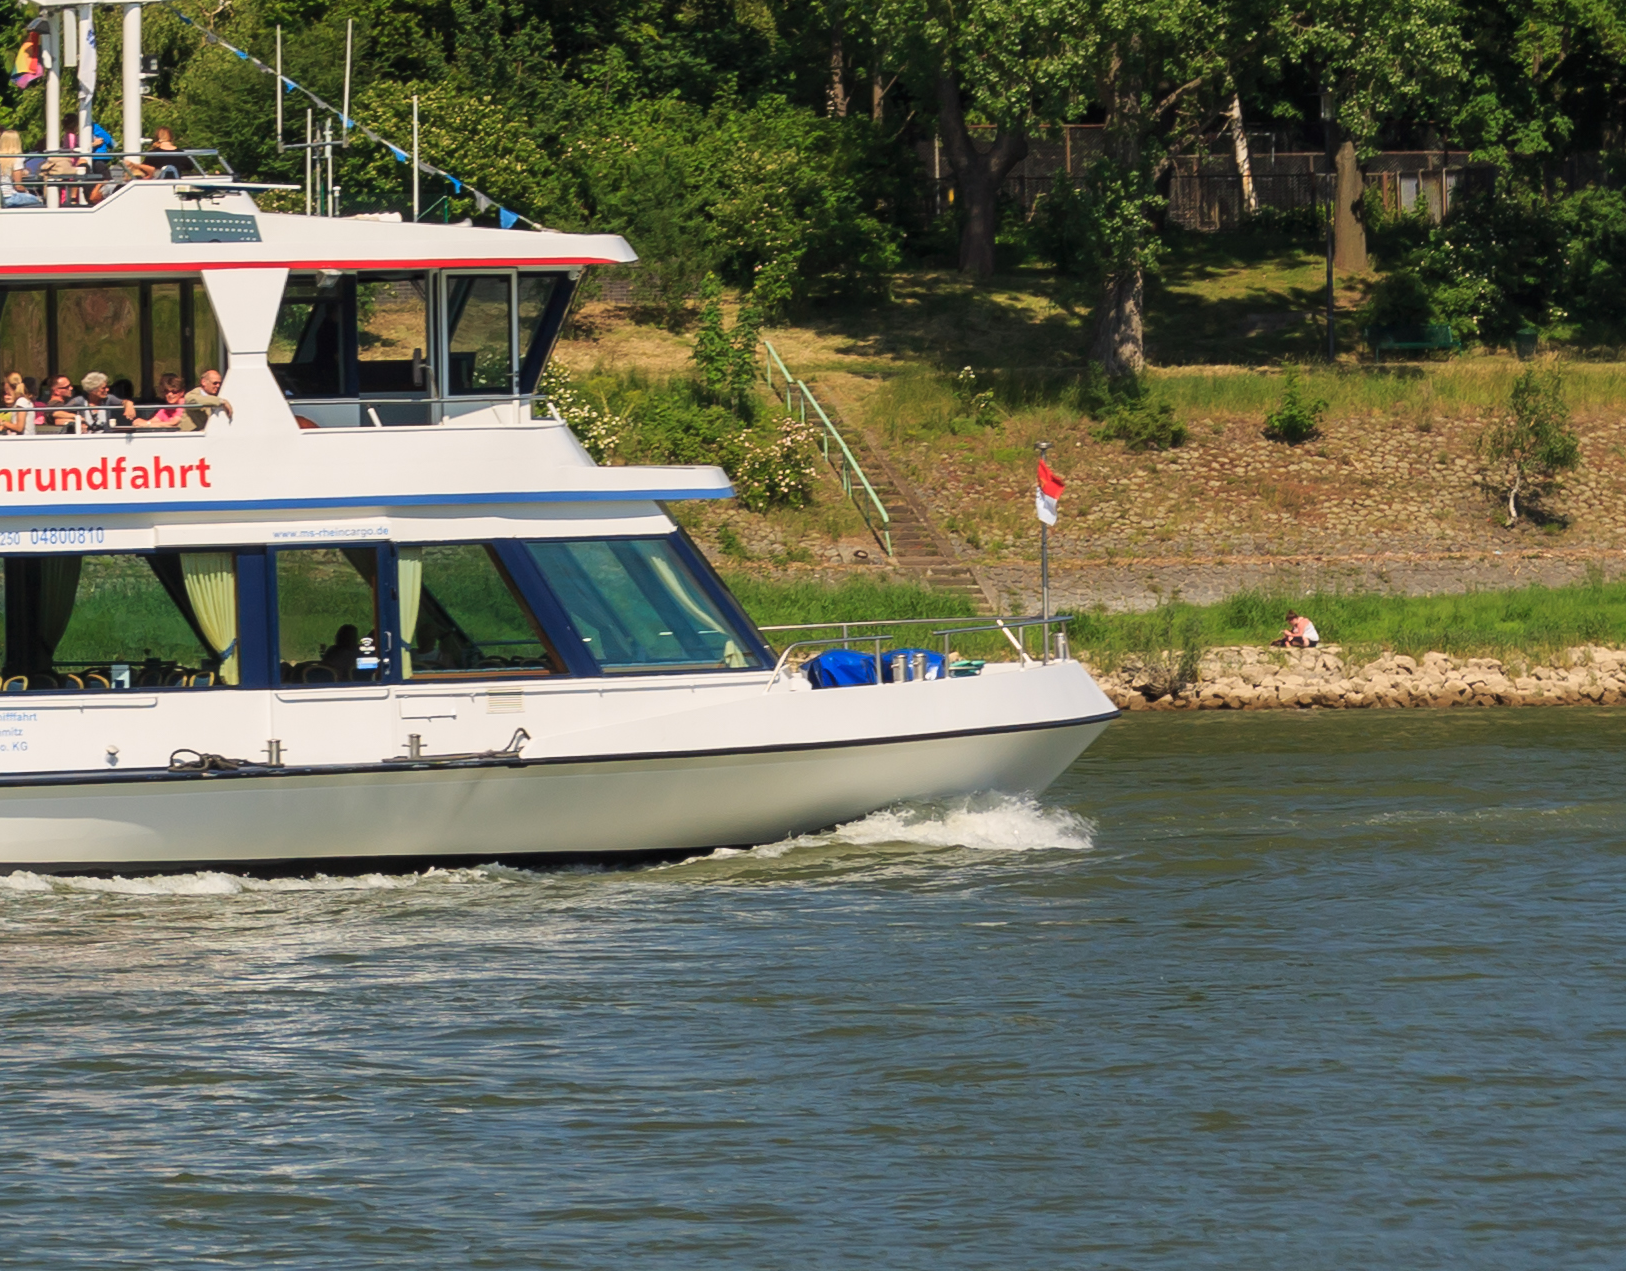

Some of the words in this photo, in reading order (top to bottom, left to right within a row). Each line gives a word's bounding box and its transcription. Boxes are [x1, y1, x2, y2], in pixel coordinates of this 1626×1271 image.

[30, 527, 104, 544] 04800810
[273, 526, 389, 538] www.ms-rheincargo.de
[12, 741, 28, 751] KG
